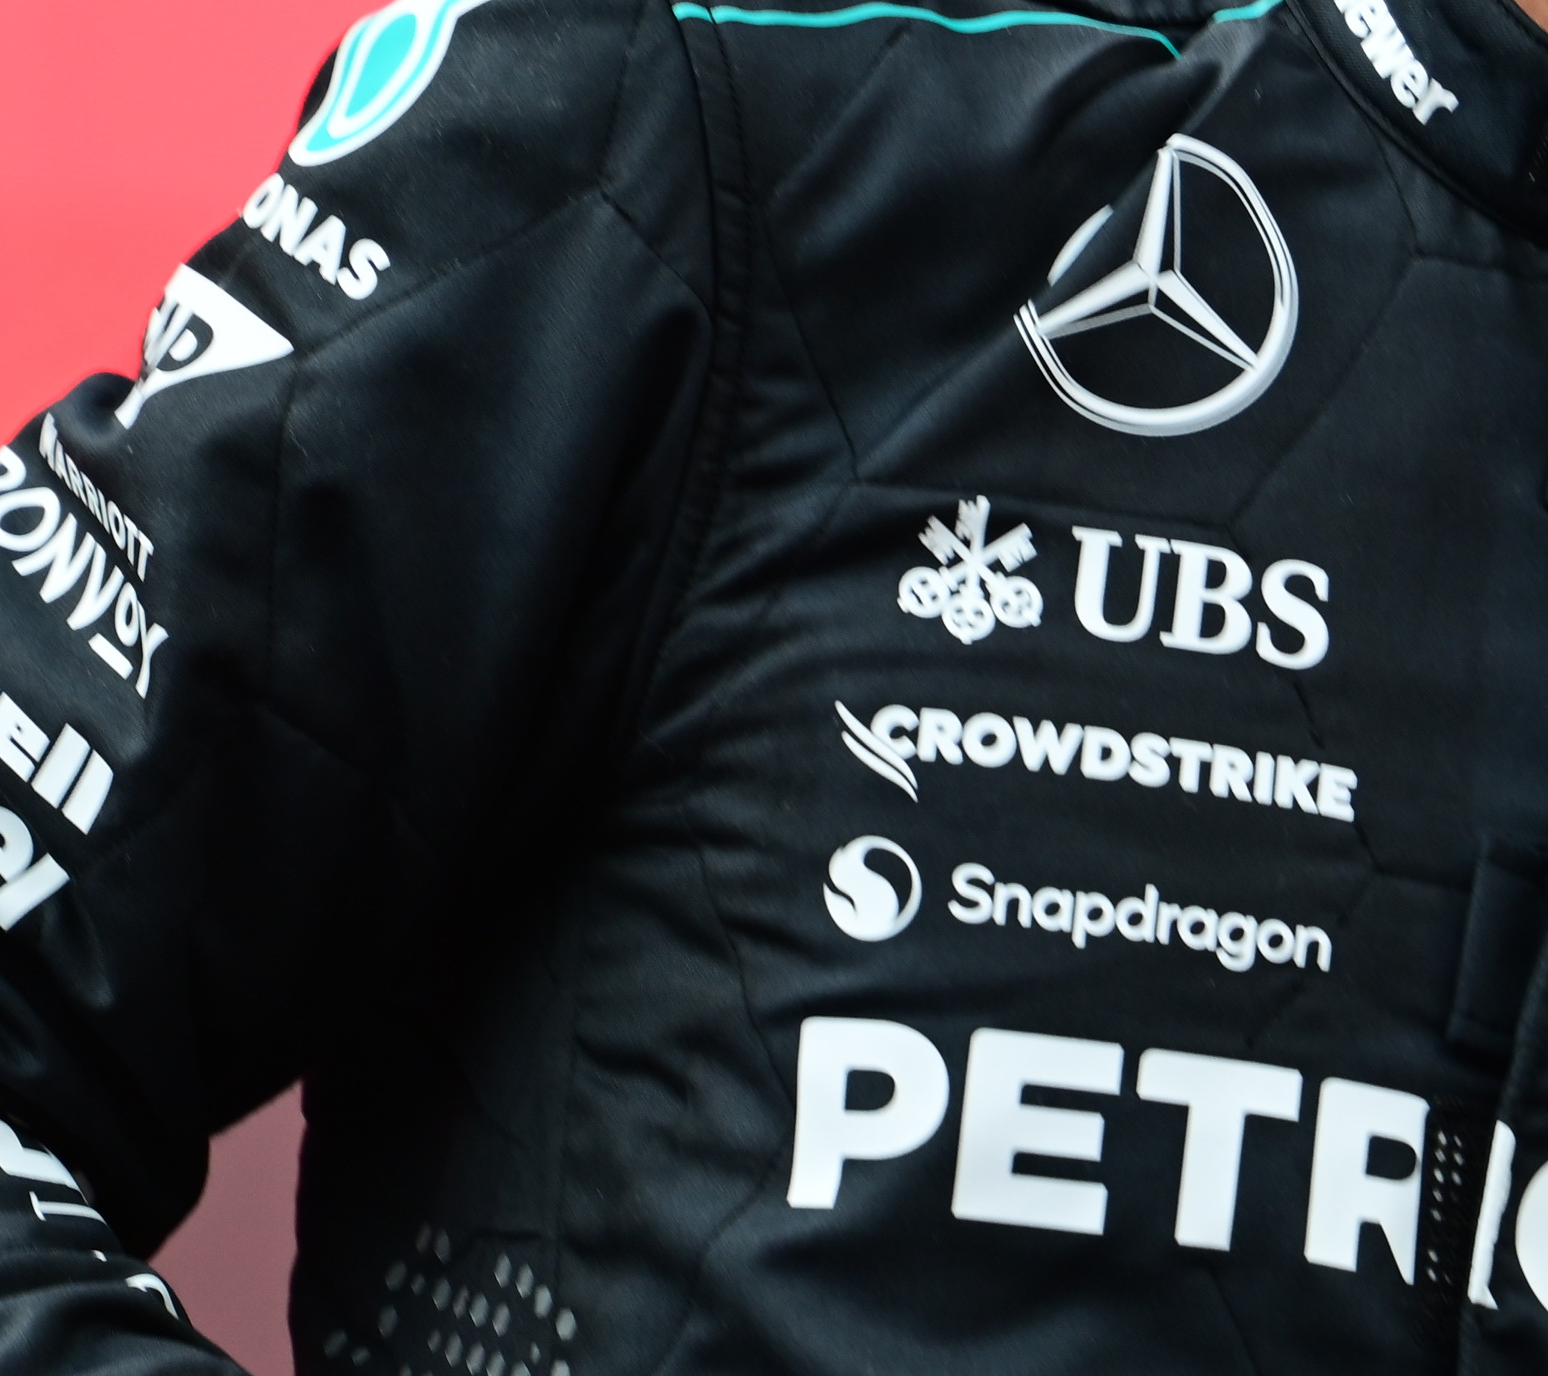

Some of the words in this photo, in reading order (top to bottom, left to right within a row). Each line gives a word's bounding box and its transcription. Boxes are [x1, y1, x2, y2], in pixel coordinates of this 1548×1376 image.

[240, 172, 391, 300] ONAS
[1071, 525, 1330, 670] UBS
[868, 703, 1359, 823] CROWDSTRIKE
[948, 862, 1332, 973] Snapdragon
